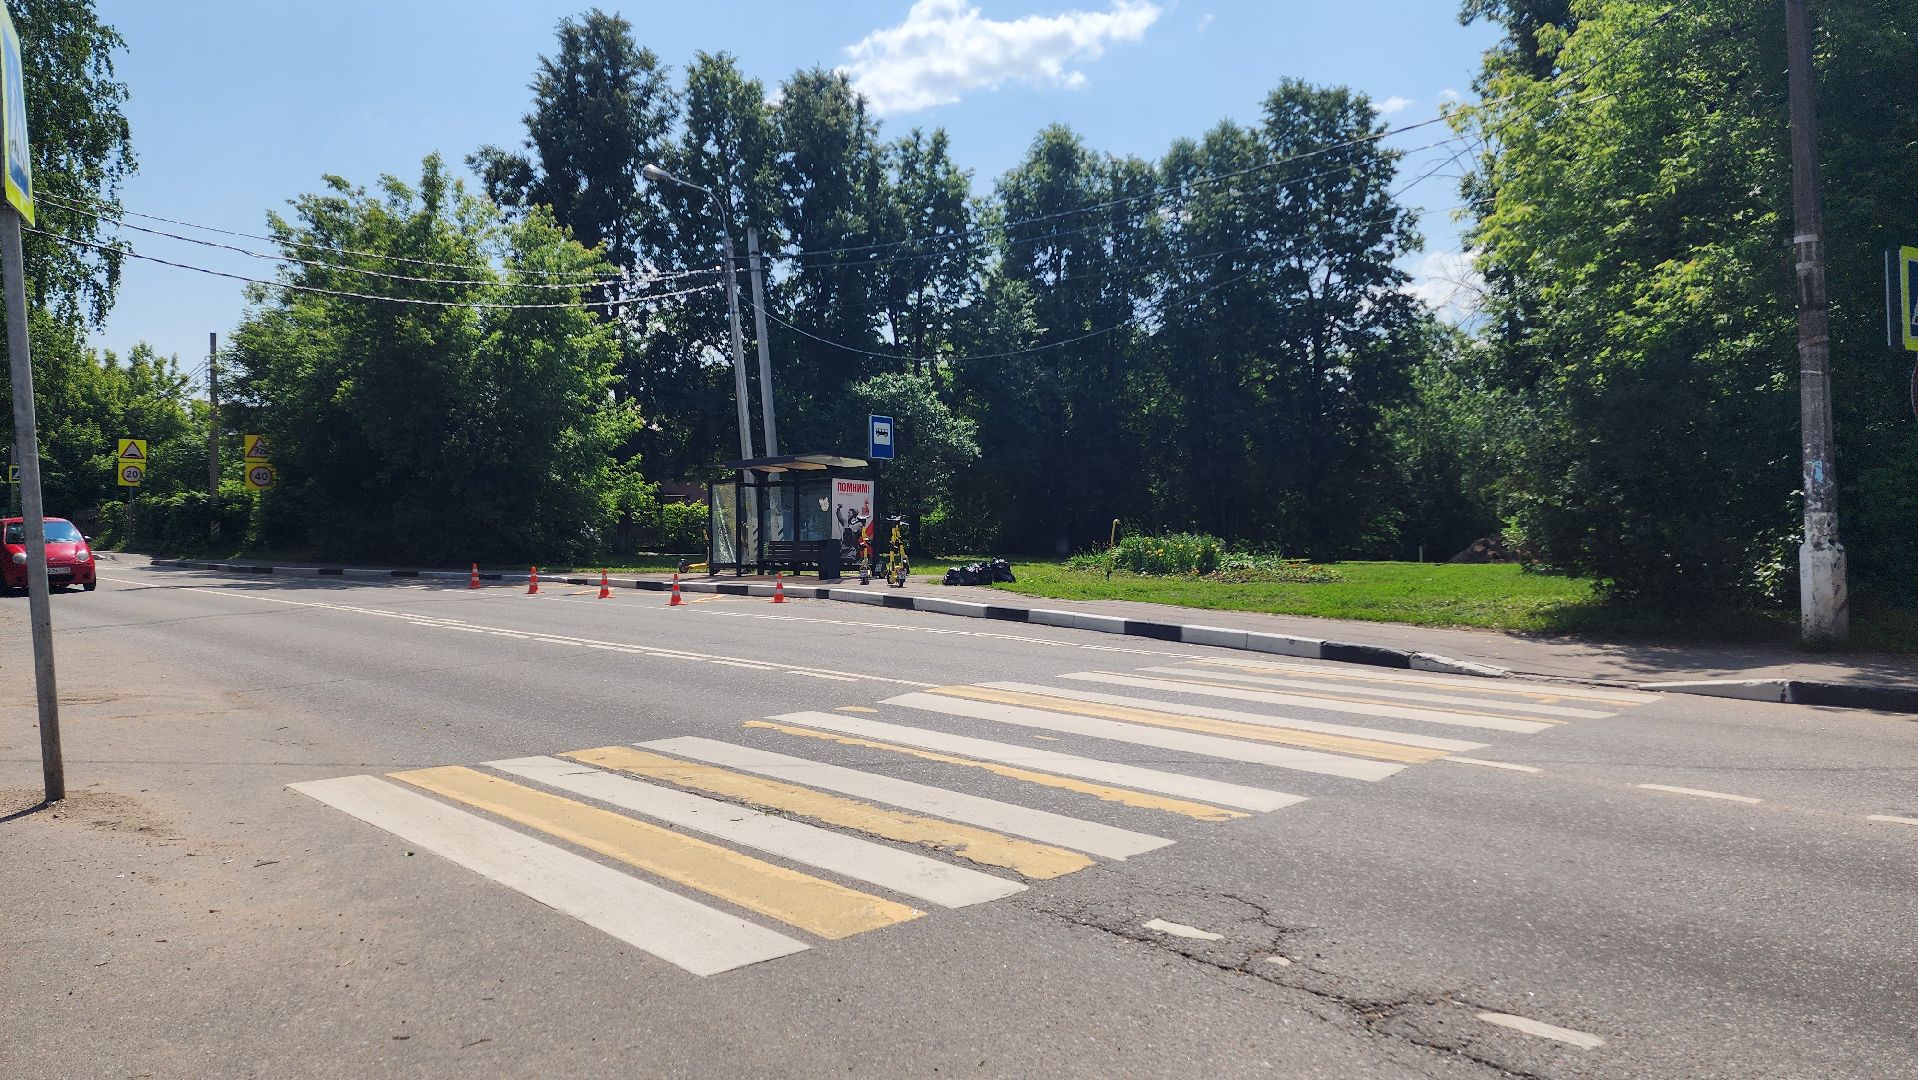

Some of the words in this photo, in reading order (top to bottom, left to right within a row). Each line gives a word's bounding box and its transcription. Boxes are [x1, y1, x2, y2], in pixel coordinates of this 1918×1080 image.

[126, 470, 138, 479] 20
[254, 472, 268, 481] 40
[837, 482, 870, 494] ПОМНИМ!
